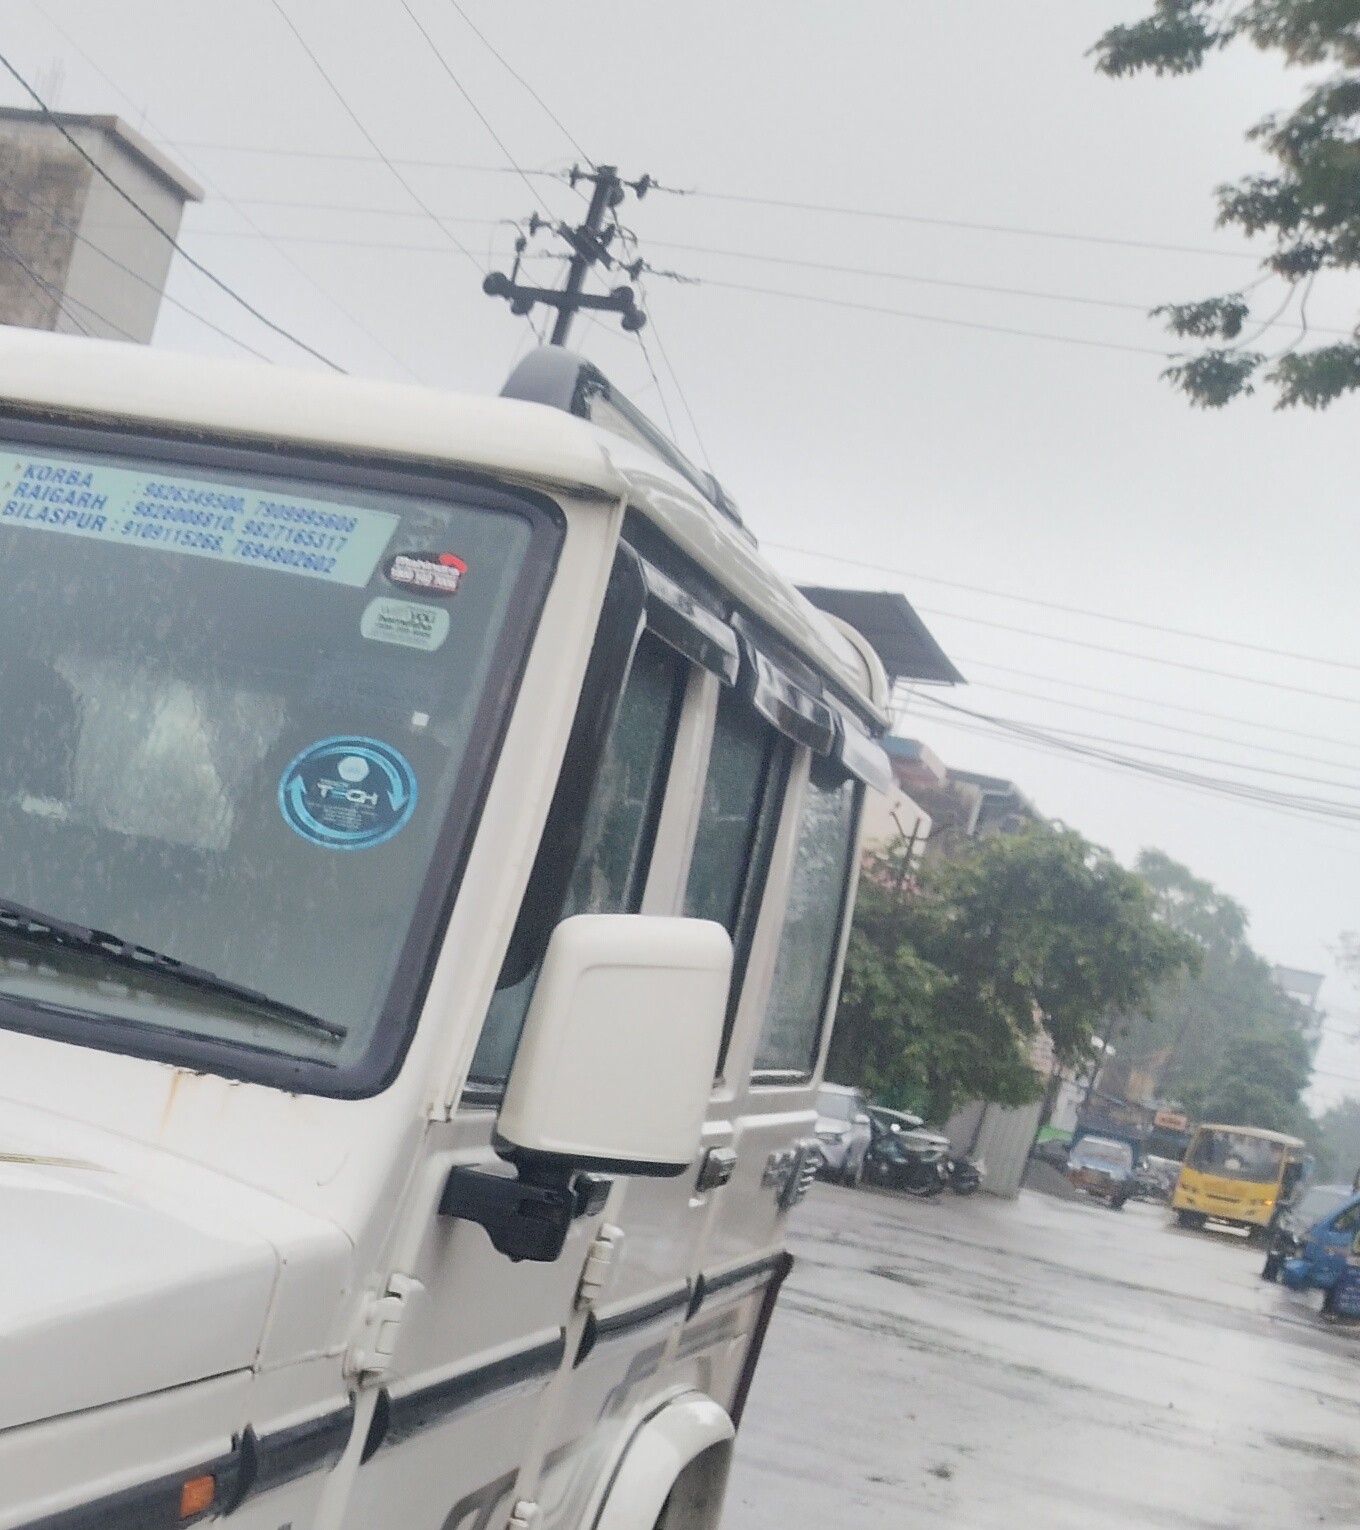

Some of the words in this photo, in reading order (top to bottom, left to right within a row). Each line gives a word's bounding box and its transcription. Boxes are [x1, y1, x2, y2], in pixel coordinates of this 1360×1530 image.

[23, 463, 94, 488] KORBA
[13, 480, 109, 511] RAIGARH
[1, 500, 108, 532] BILASPUR
